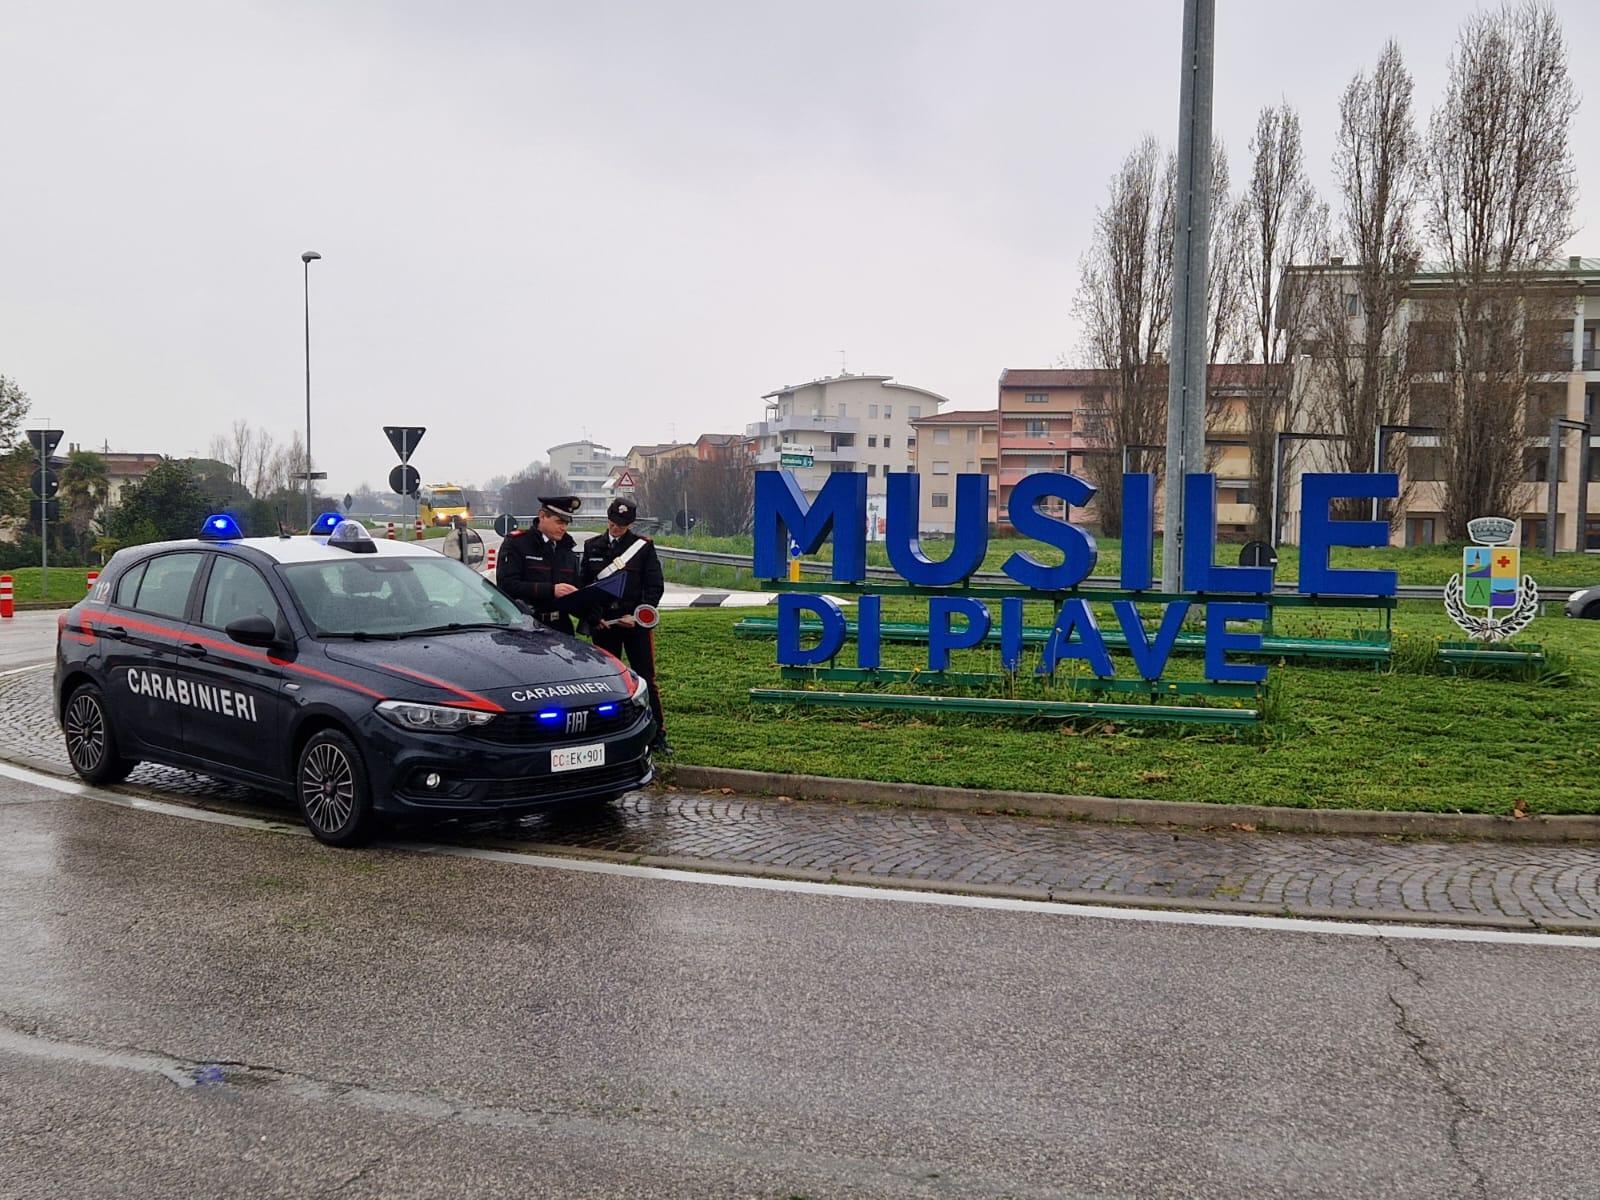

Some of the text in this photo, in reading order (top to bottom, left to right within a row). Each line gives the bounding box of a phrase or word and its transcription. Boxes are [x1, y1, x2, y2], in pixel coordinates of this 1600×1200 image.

[753, 470, 1399, 595] MUSILE
[777, 591, 1269, 682] DI PIAVE
[127, 668, 257, 722] CARABINIERI
[511, 682, 613, 702] CARABINIERI
[565, 710, 589, 734] FIAT
